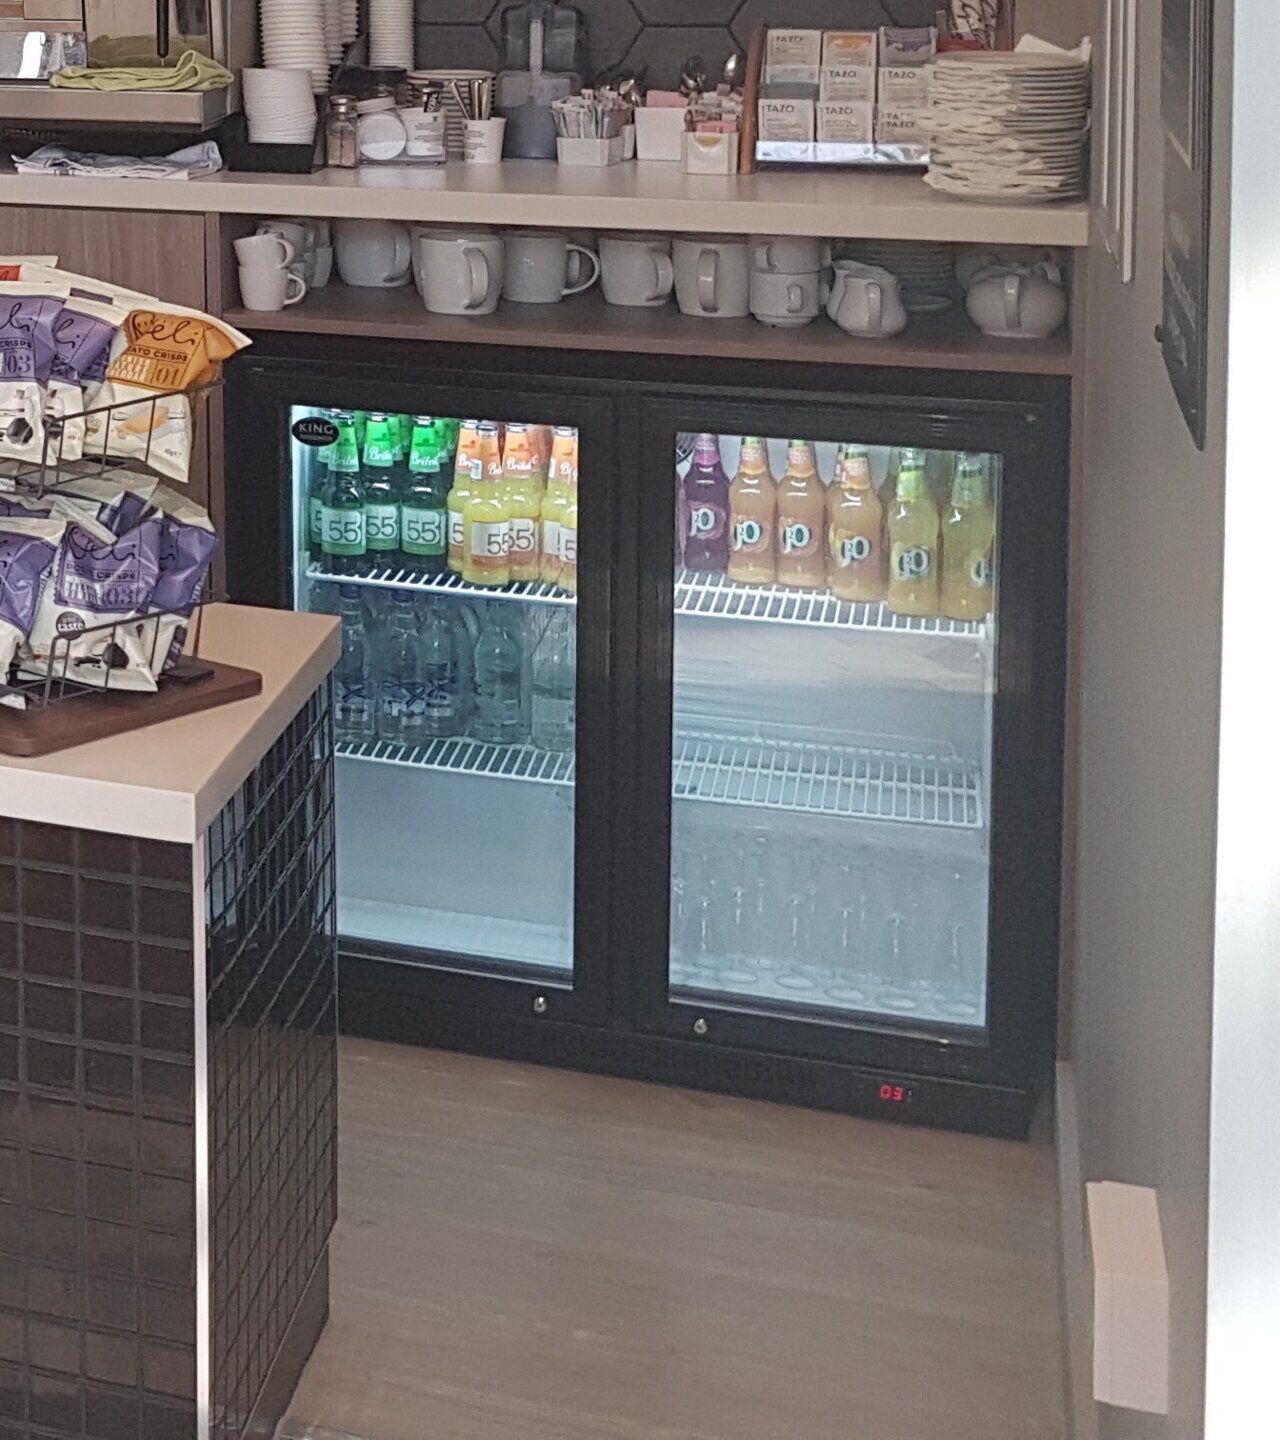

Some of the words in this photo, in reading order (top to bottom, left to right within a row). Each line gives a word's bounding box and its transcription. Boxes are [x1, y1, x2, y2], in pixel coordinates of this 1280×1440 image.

[776, 35, 804, 43] TAZO
[829, 70, 857, 78] TAZO
[887, 70, 916, 78] TAZO
[765, 105, 795, 113] TAZO
[824, 107, 853, 115] TAZO
[0, 338, 33, 349] CRISPS
[153, 350, 188, 362] CRISPS
[4, 352, 32, 375] 03
[298, 422, 334, 435] KING
[328, 520, 361, 543] 55
[366, 515, 396, 538] 55
[406, 519, 438, 543] 55
[105, 586, 135, 606] 03
[57, 622, 85, 633] taste
